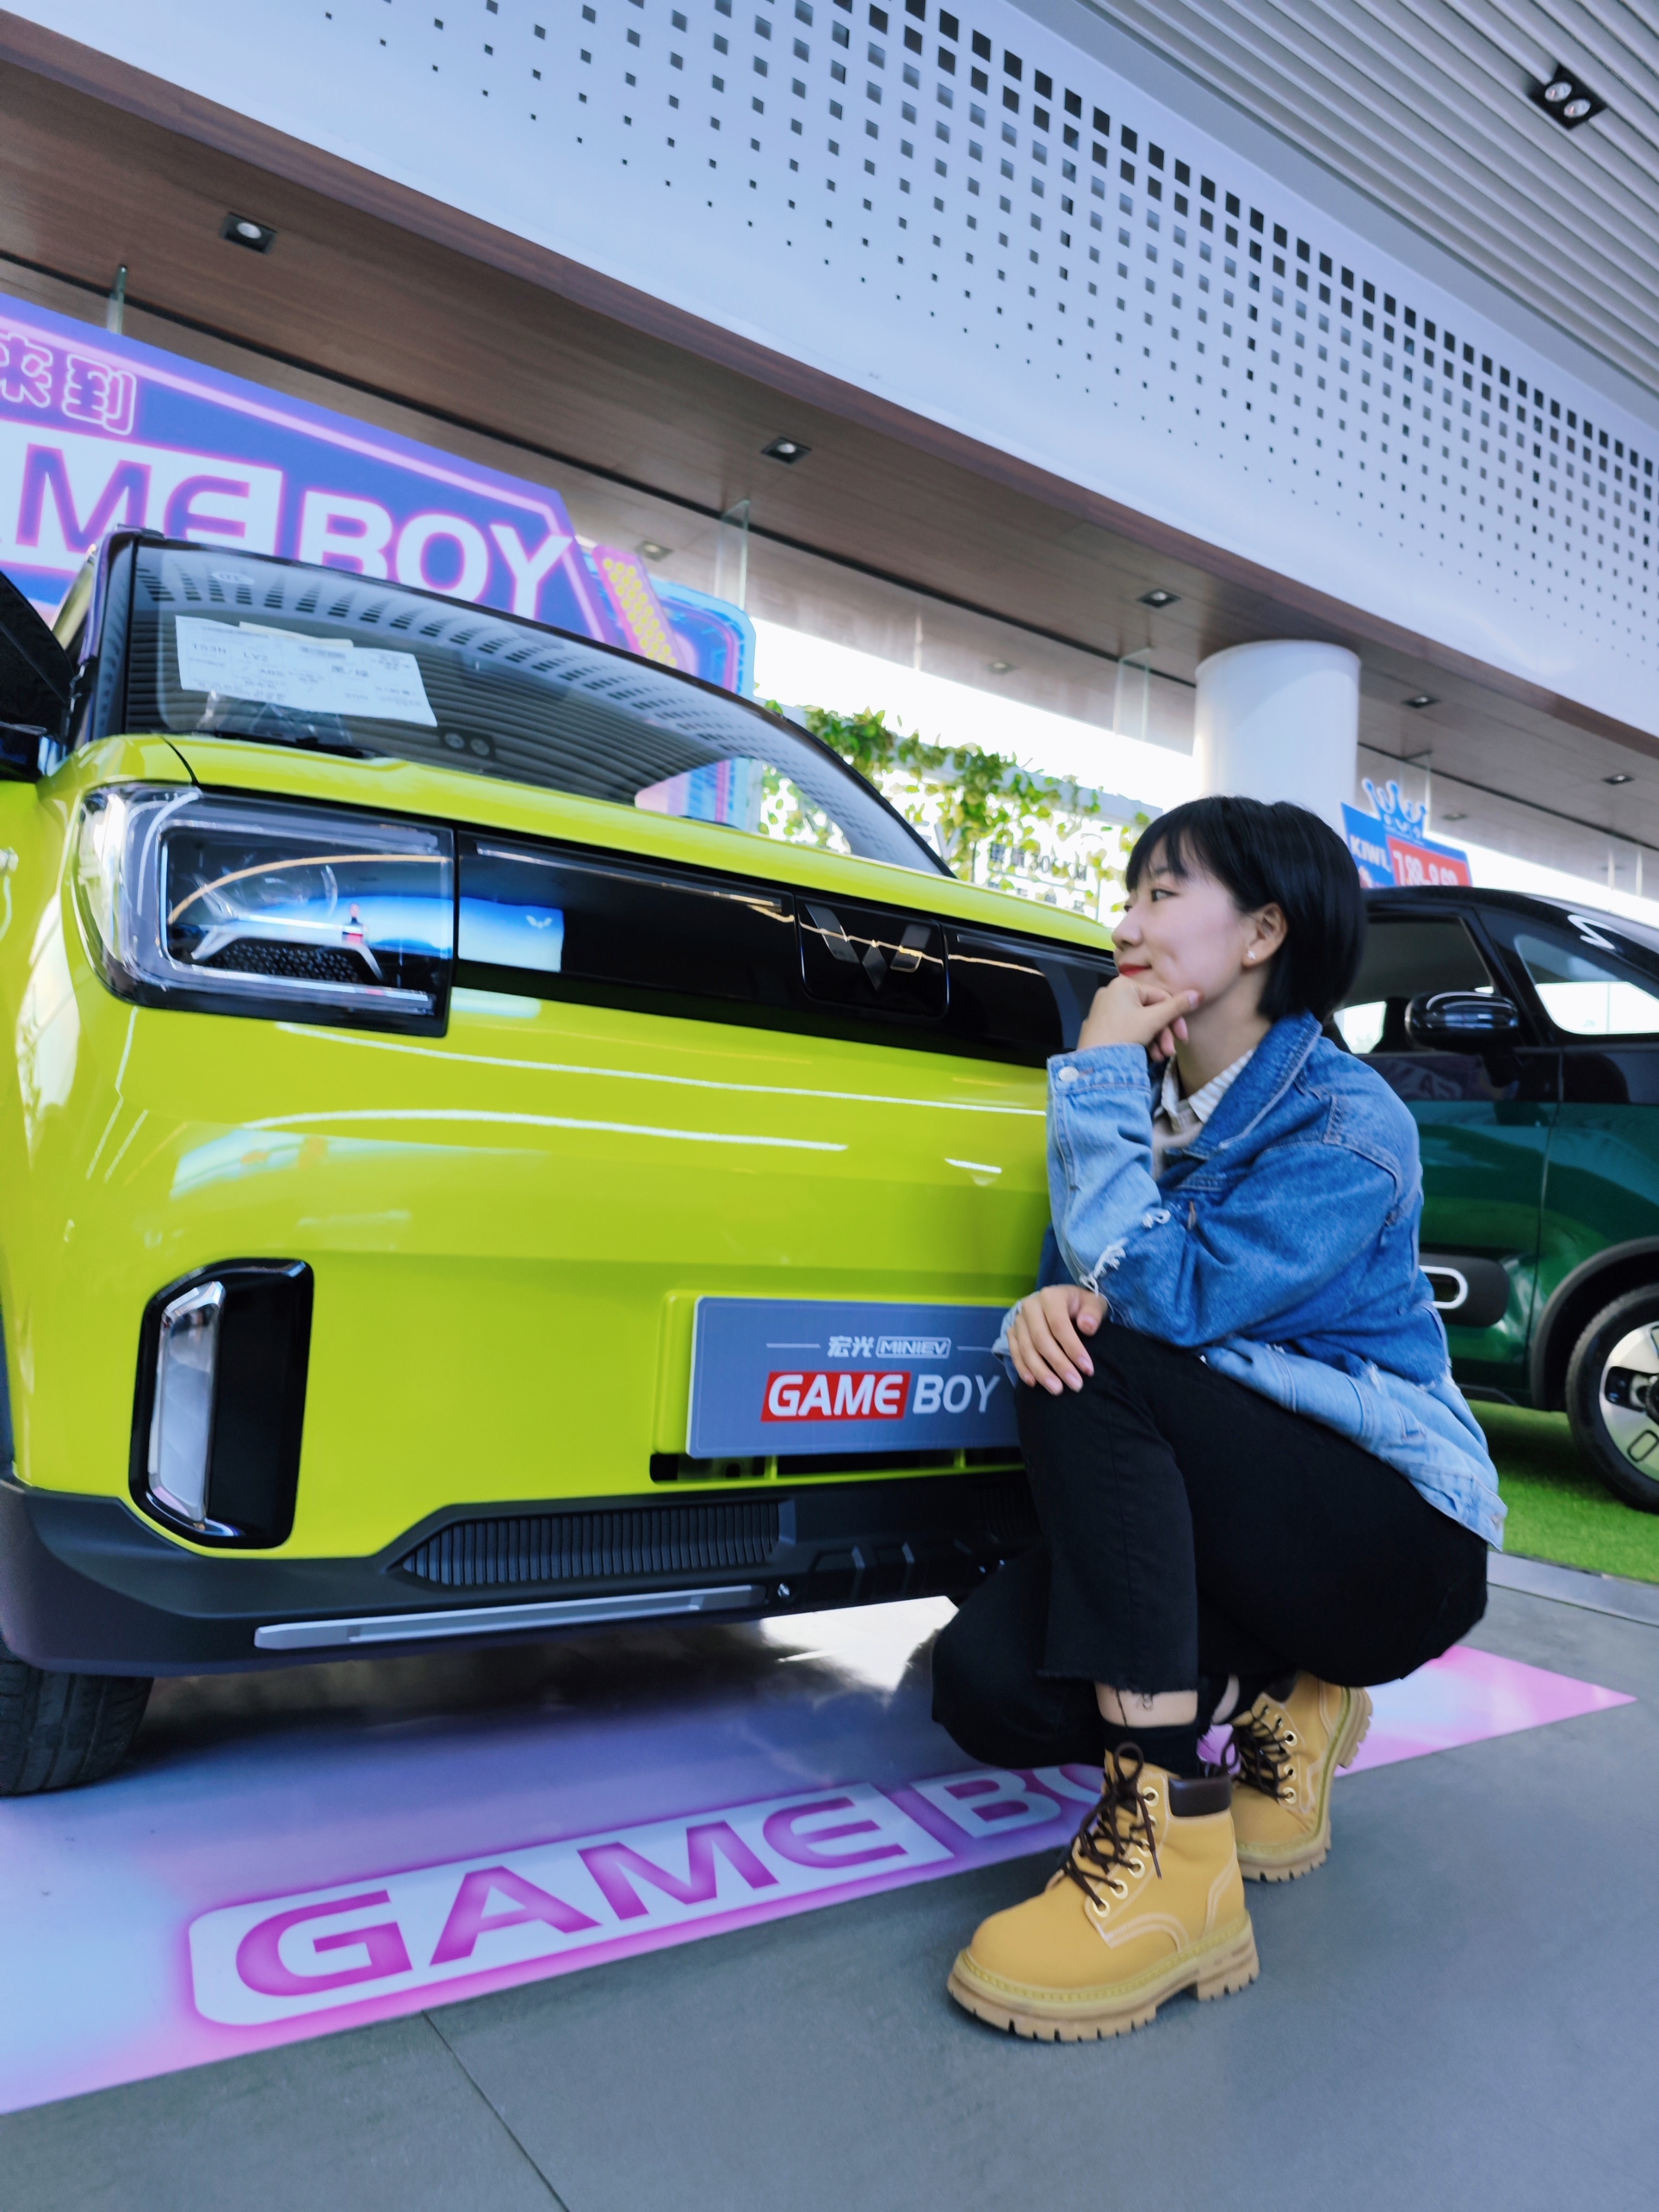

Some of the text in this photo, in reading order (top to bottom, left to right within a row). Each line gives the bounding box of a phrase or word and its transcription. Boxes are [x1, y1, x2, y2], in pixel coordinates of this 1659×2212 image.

[298, 489, 574, 621] BOY
[827, 1335, 875, 1358] 宏光
[768, 1373, 1002, 1417] GAME BOY
[235, 1797, 909, 1997] GAME
